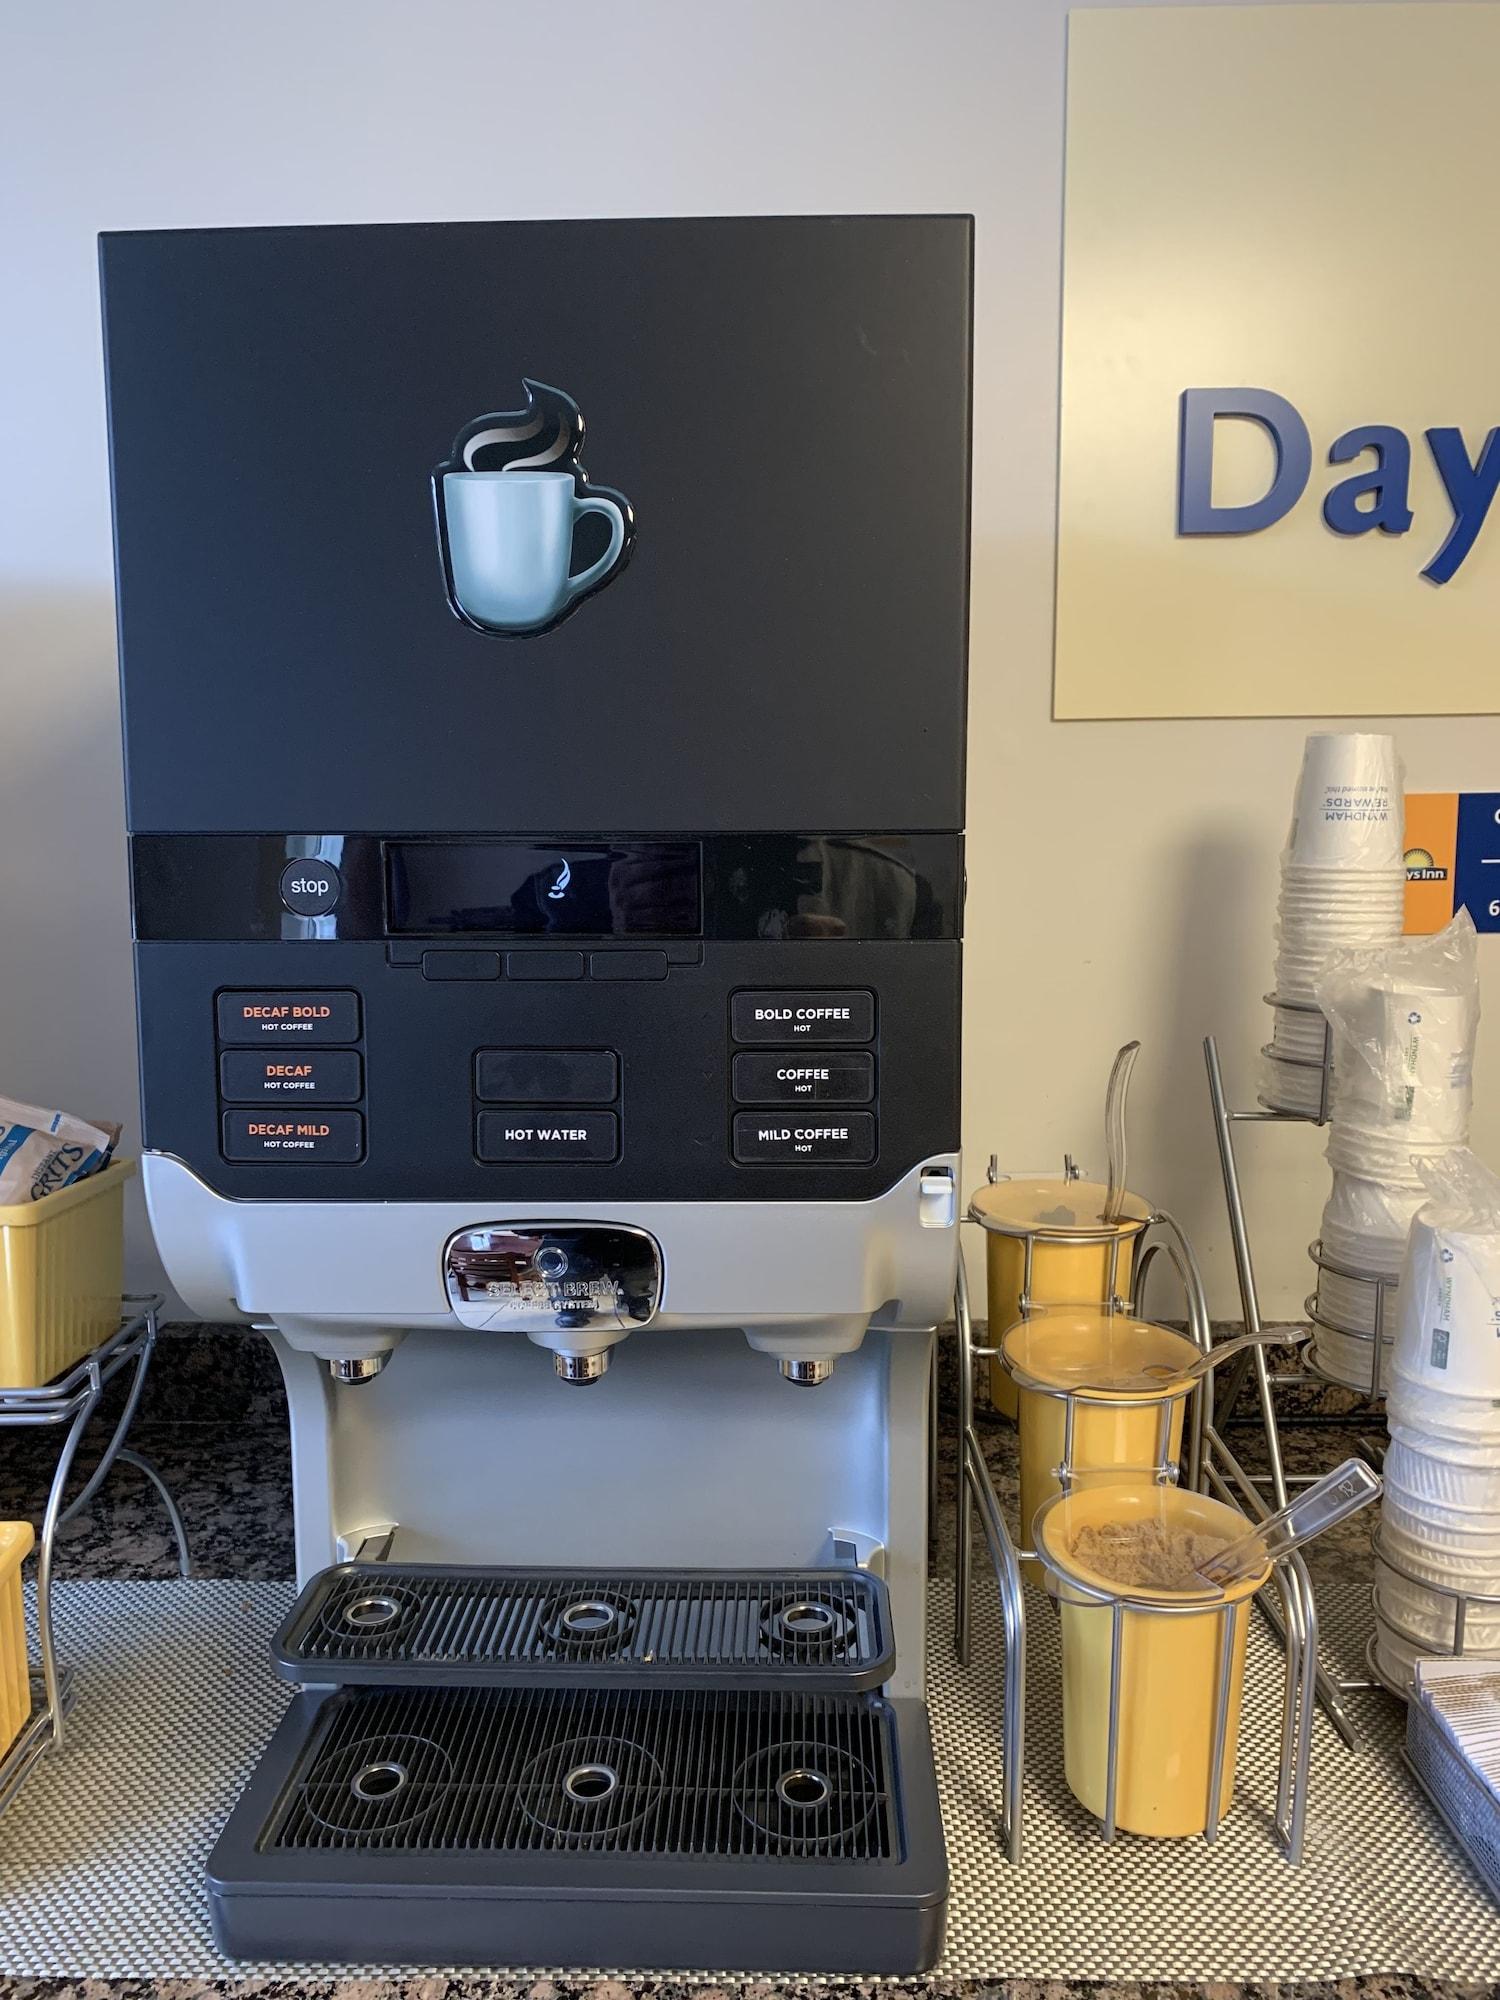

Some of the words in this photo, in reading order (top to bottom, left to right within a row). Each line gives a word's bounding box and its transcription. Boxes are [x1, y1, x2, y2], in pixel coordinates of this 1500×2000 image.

[1325, 812, 1388, 821] WYNDHAM
[1406, 870, 1421, 881] ys
[1422, 868, 1445, 880] Inn
[291, 876, 329, 897] stop
[243, 1006, 289, 1018] DECAF
[292, 1006, 331, 1018] BOLD
[754, 1008, 793, 1021] BOLD
[795, 1007, 850, 1020] COFFEE
[261, 1023, 280, 1031] HOT
[281, 1023, 314, 1031] COFFEE
[793, 1024, 811, 1032] HOT
[1409, 1036, 1420, 1075] WYNDHA
[266, 1065, 313, 1077] DECAF
[776, 1068, 829, 1081] COFFEE
[263, 1082, 281, 1090] HOT
[282, 1082, 316, 1090] COFFEE
[794, 1084, 812, 1092] HOT
[248, 1124, 294, 1136] DECAF
[296, 1124, 330, 1136] MILD
[504, 1128, 534, 1141] HOT
[536, 1129, 587, 1141] WATER
[757, 1129, 792, 1141] MILD
[793, 1127, 849, 1141] COFFEE
[282, 1141, 315, 1149] COFFEE
[794, 1144, 812, 1152] HOT
[31, 1142, 84, 1201] GRITS
[563, 1280, 619, 1297] BREW
